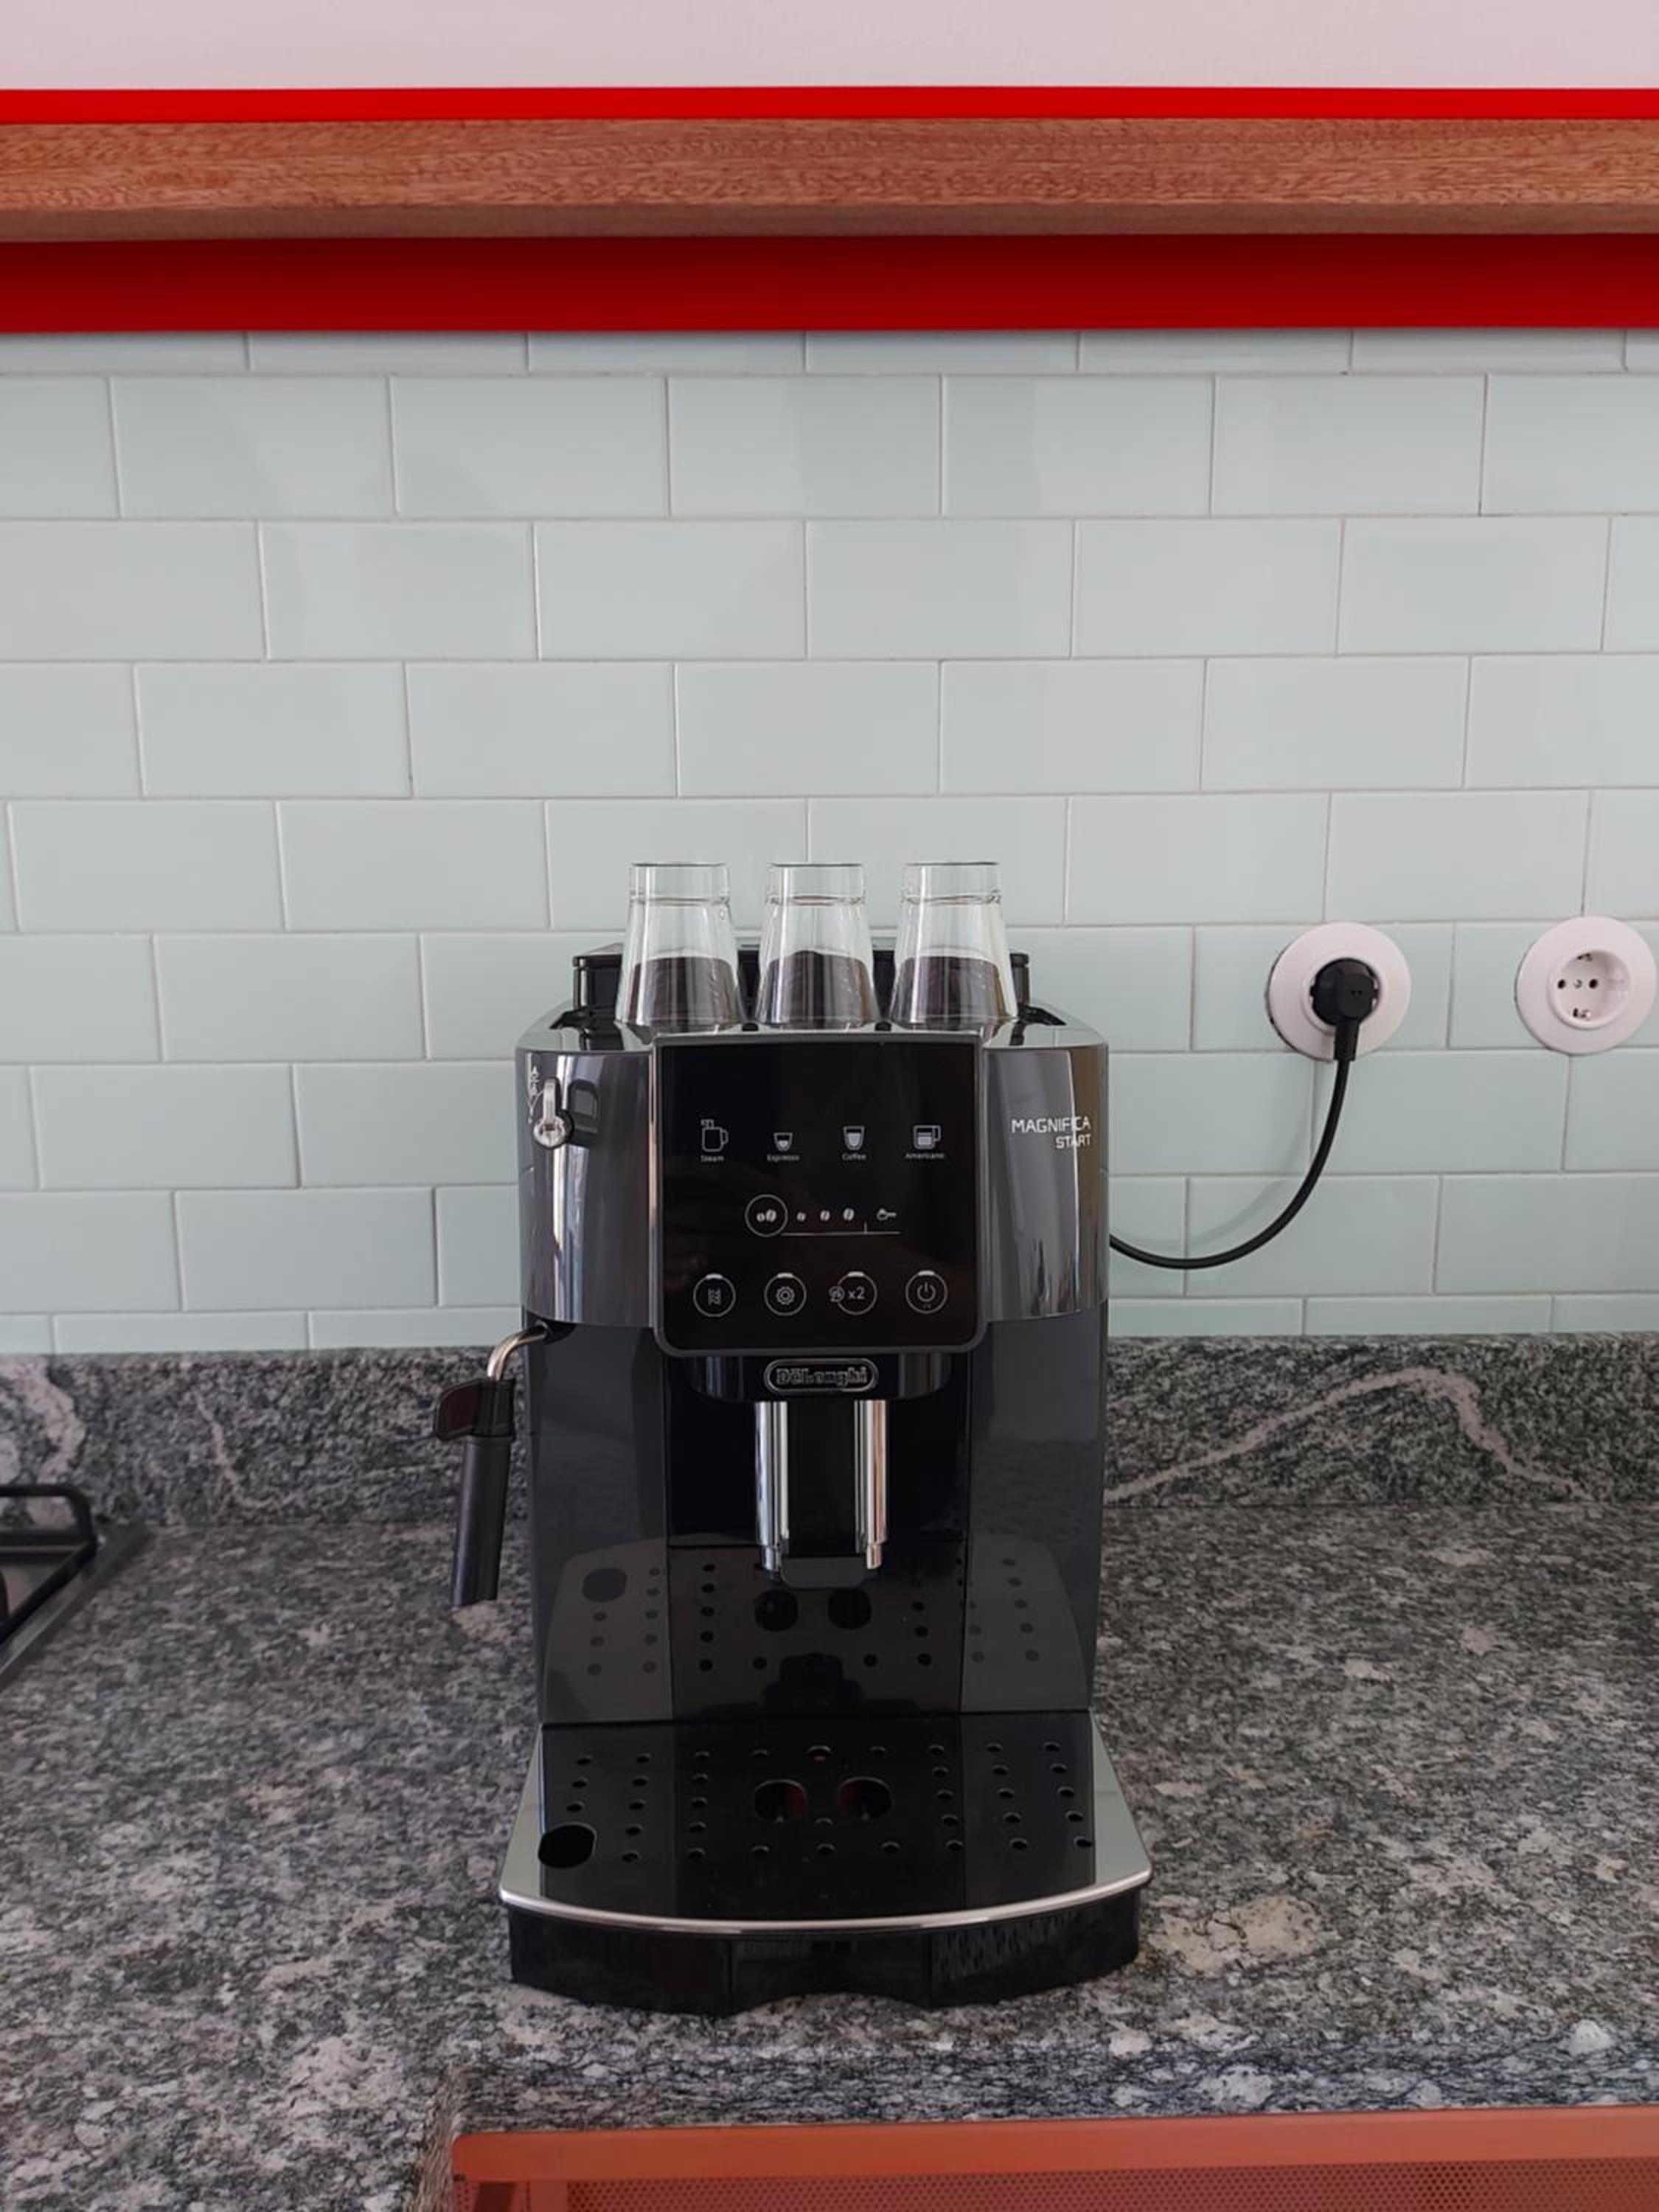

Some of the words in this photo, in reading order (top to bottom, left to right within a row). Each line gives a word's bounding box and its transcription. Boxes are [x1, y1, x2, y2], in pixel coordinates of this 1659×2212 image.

[1011, 1116, 1091, 1133] MAGNIFICA
[1055, 1134, 1091, 1149] START
[841, 1152, 866, 1161] Coffee
[848, 1286, 865, 1301] x2
